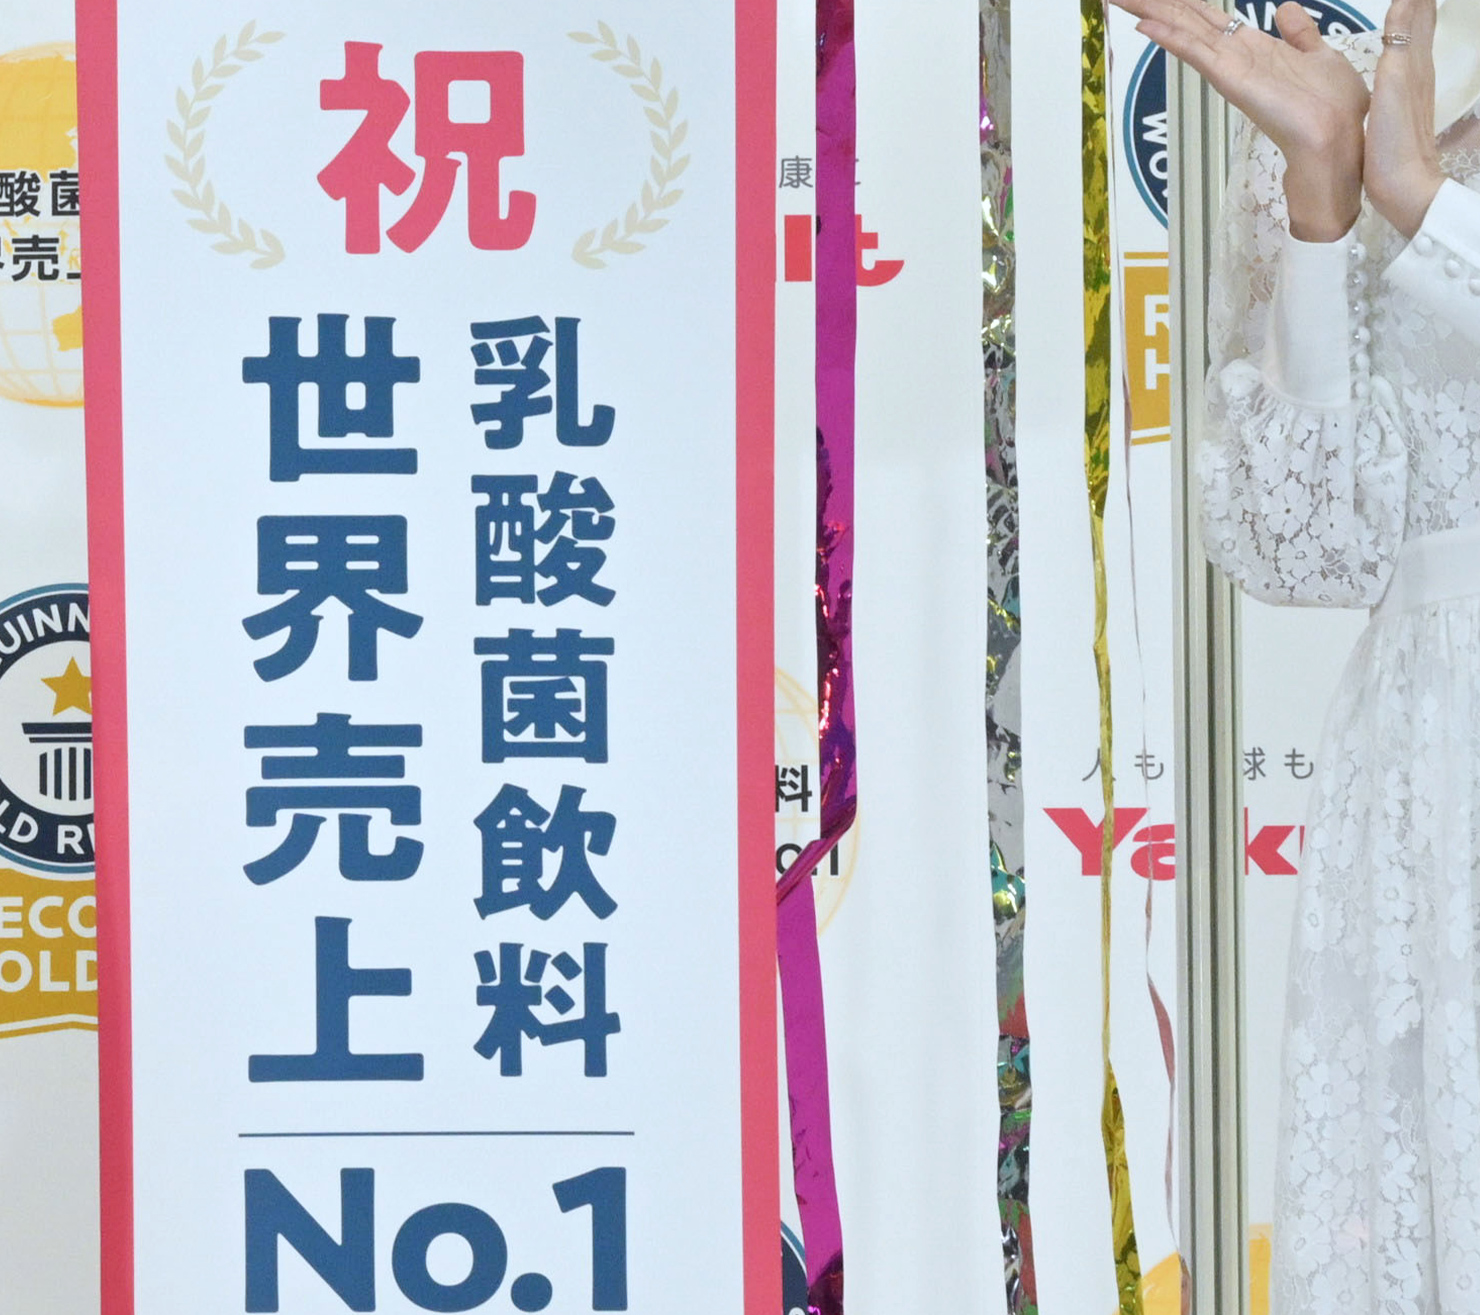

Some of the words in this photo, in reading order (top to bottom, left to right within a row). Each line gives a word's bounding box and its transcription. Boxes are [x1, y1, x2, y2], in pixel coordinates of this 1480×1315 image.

[317, 40, 537, 255] 祝
[241, 314, 425, 1083] 世界売上
[470, 315, 622, 1079] 乳酸菌飲料
[244, 1166, 630, 1313] No.1
